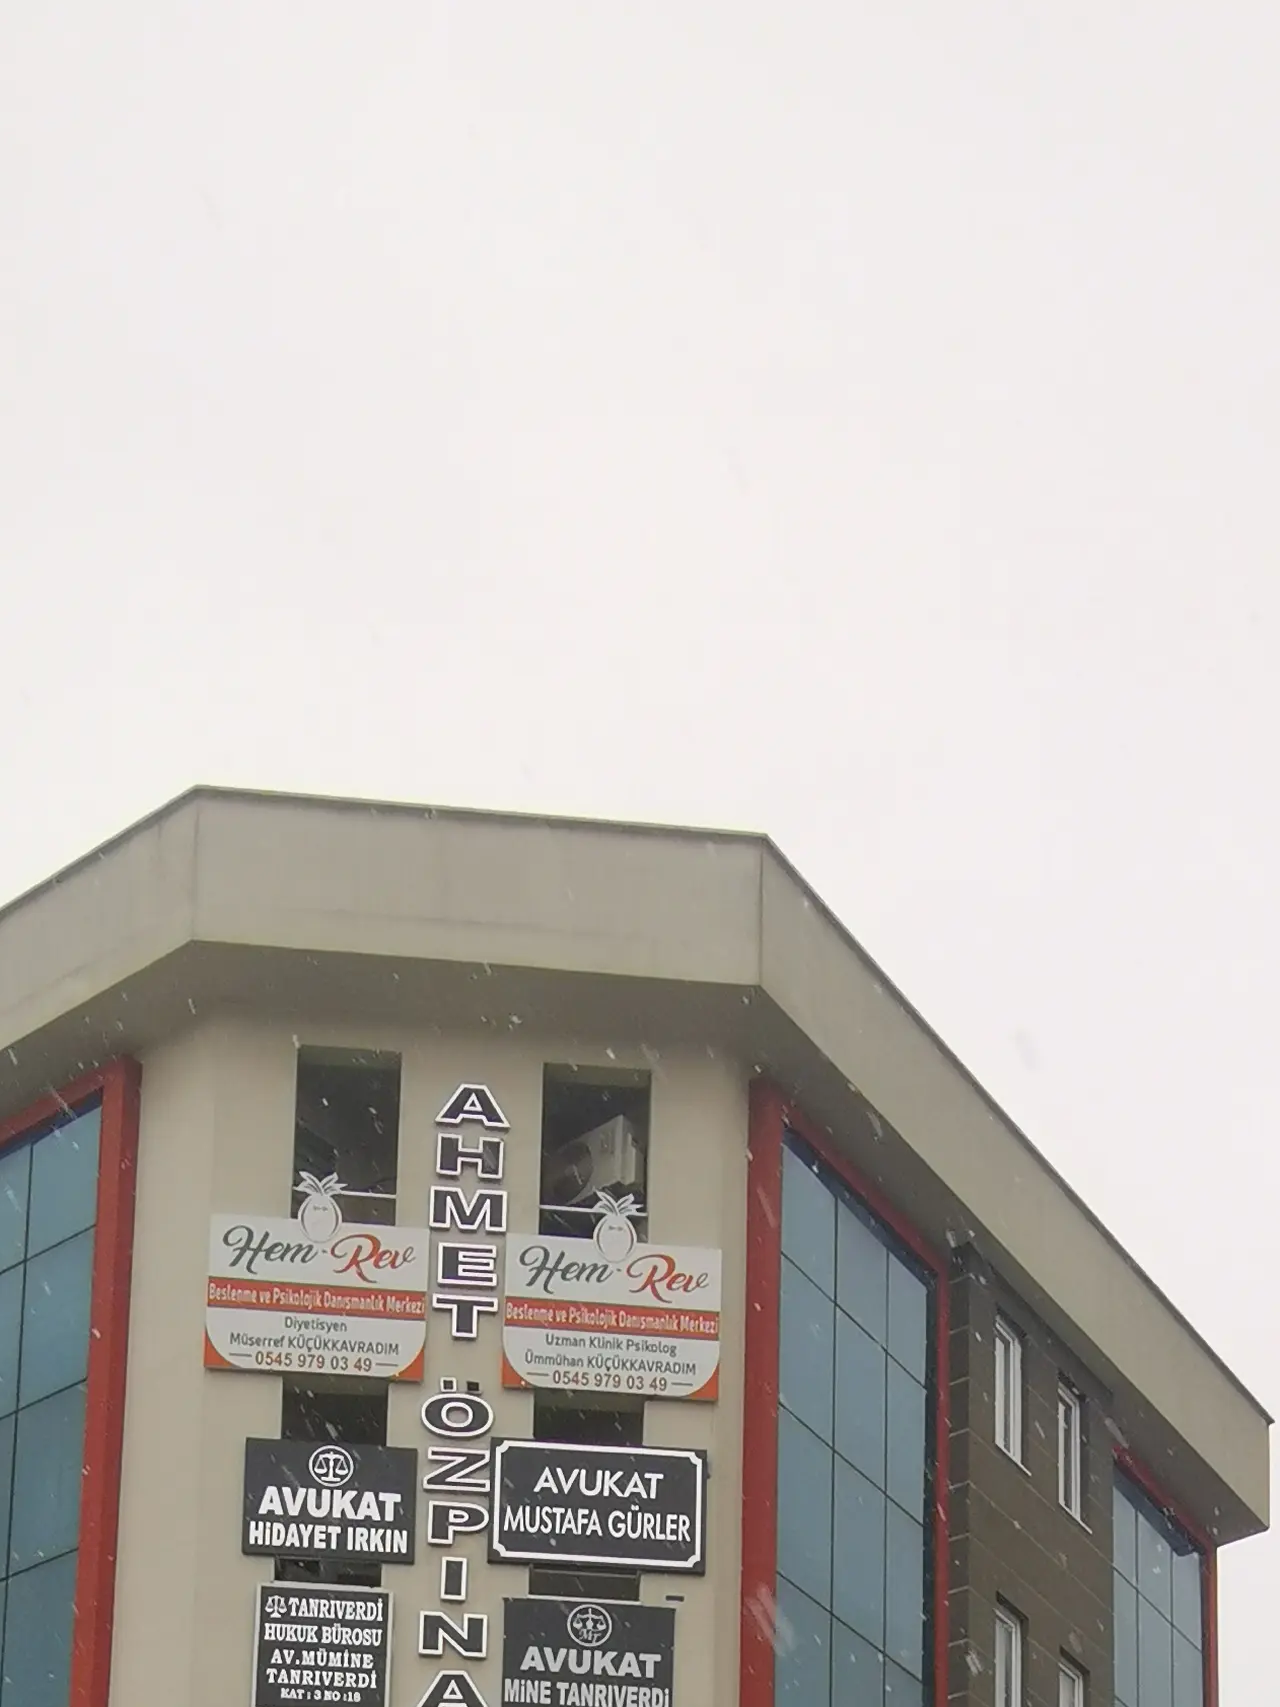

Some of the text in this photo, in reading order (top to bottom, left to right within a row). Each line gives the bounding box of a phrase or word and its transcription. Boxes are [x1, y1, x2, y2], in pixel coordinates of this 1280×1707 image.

[429, 1083, 510, 1340] AHMET
[208, 1283, 257, 1304] Beslenme
[259, 1290, 271, 1304] ve
[272, 1288, 322, 1311] Psikolojik
[386, 1296, 425, 1315] Merkezi
[284, 1316, 348, 1334] Diyetisyen
[506, 1303, 553, 1322] Beslenme
[555, 1309, 567, 1323] ve
[568, 1307, 618, 1329] Psikolojik
[680, 1314, 718, 1334] Merkezi
[287, 1332, 399, 1355] KÜÇÜKKAVRADIM
[546, 1334, 677, 1357] Uzman Klinik Psikolog
[255, 1351, 372, 1372] 0545 979 03 49
[586, 1352, 697, 1375] KÜÇÜKKAVRADIM
[552, 1370, 668, 1391] 0545 979 03 49
[533, 1467, 664, 1499] AVUKAT
[258, 1485, 402, 1522] AVUKAT
[504, 1505, 691, 1542] MUSTAFA GÜRLER
[347, 1526, 408, 1554] IRKIN
[288, 1597, 383, 1621] TANRIVERDİ
[264, 1623, 382, 1646] HUKUK BÜROSU
[520, 1646, 661, 1678] AVUKAT
[267, 1668, 377, 1689] TANRIVERDİ
[281, 1688, 304, 1699] KAT
